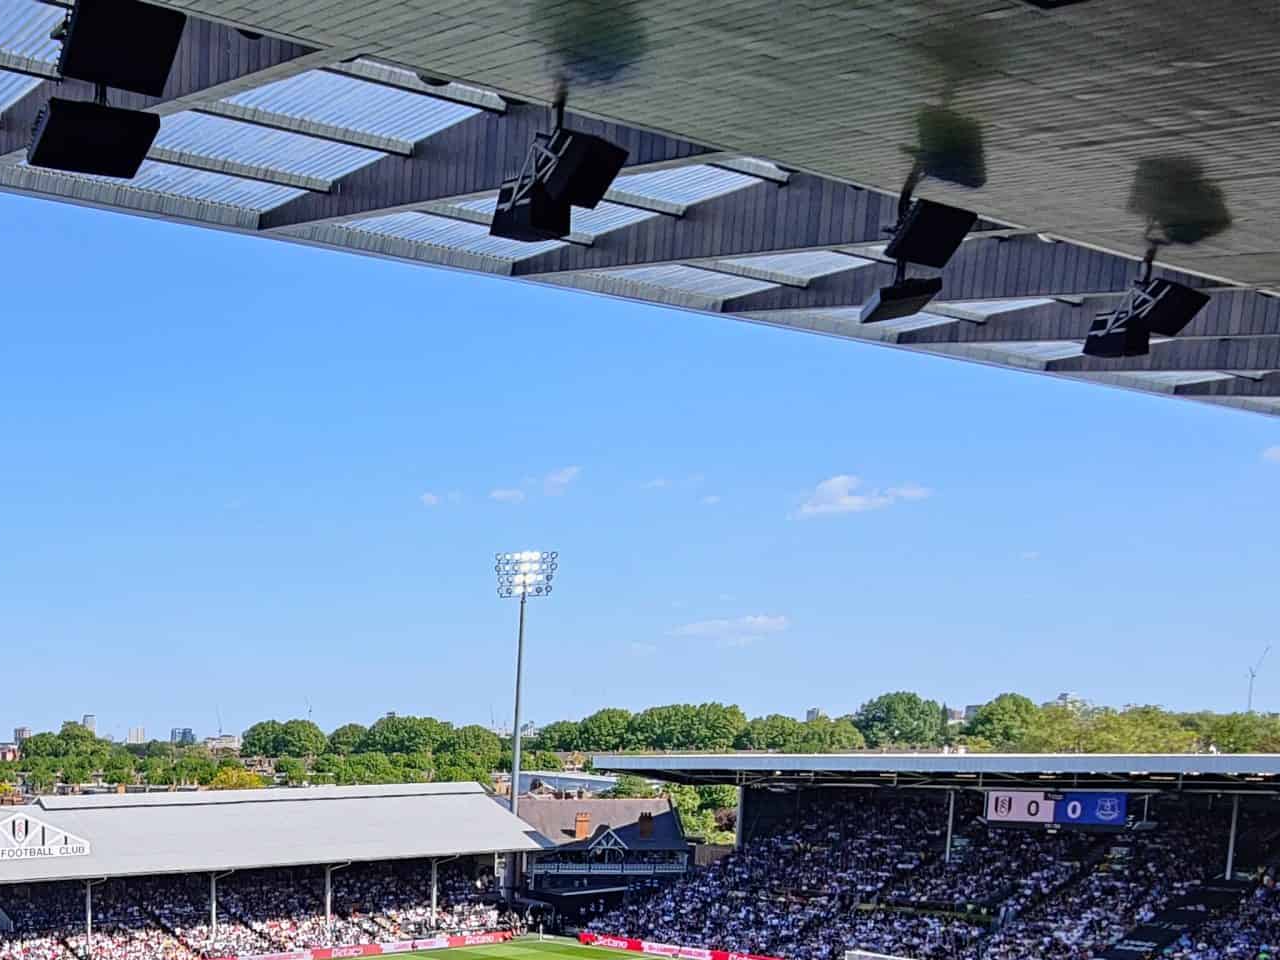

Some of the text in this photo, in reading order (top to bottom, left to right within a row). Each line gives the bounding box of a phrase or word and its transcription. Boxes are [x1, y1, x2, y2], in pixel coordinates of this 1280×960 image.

[1027, 800, 1039, 816] 0
[1067, 801, 1081, 818] 0
[1, 847, 53, 858] FOOTBALL
[59, 846, 85, 855] CLUB
